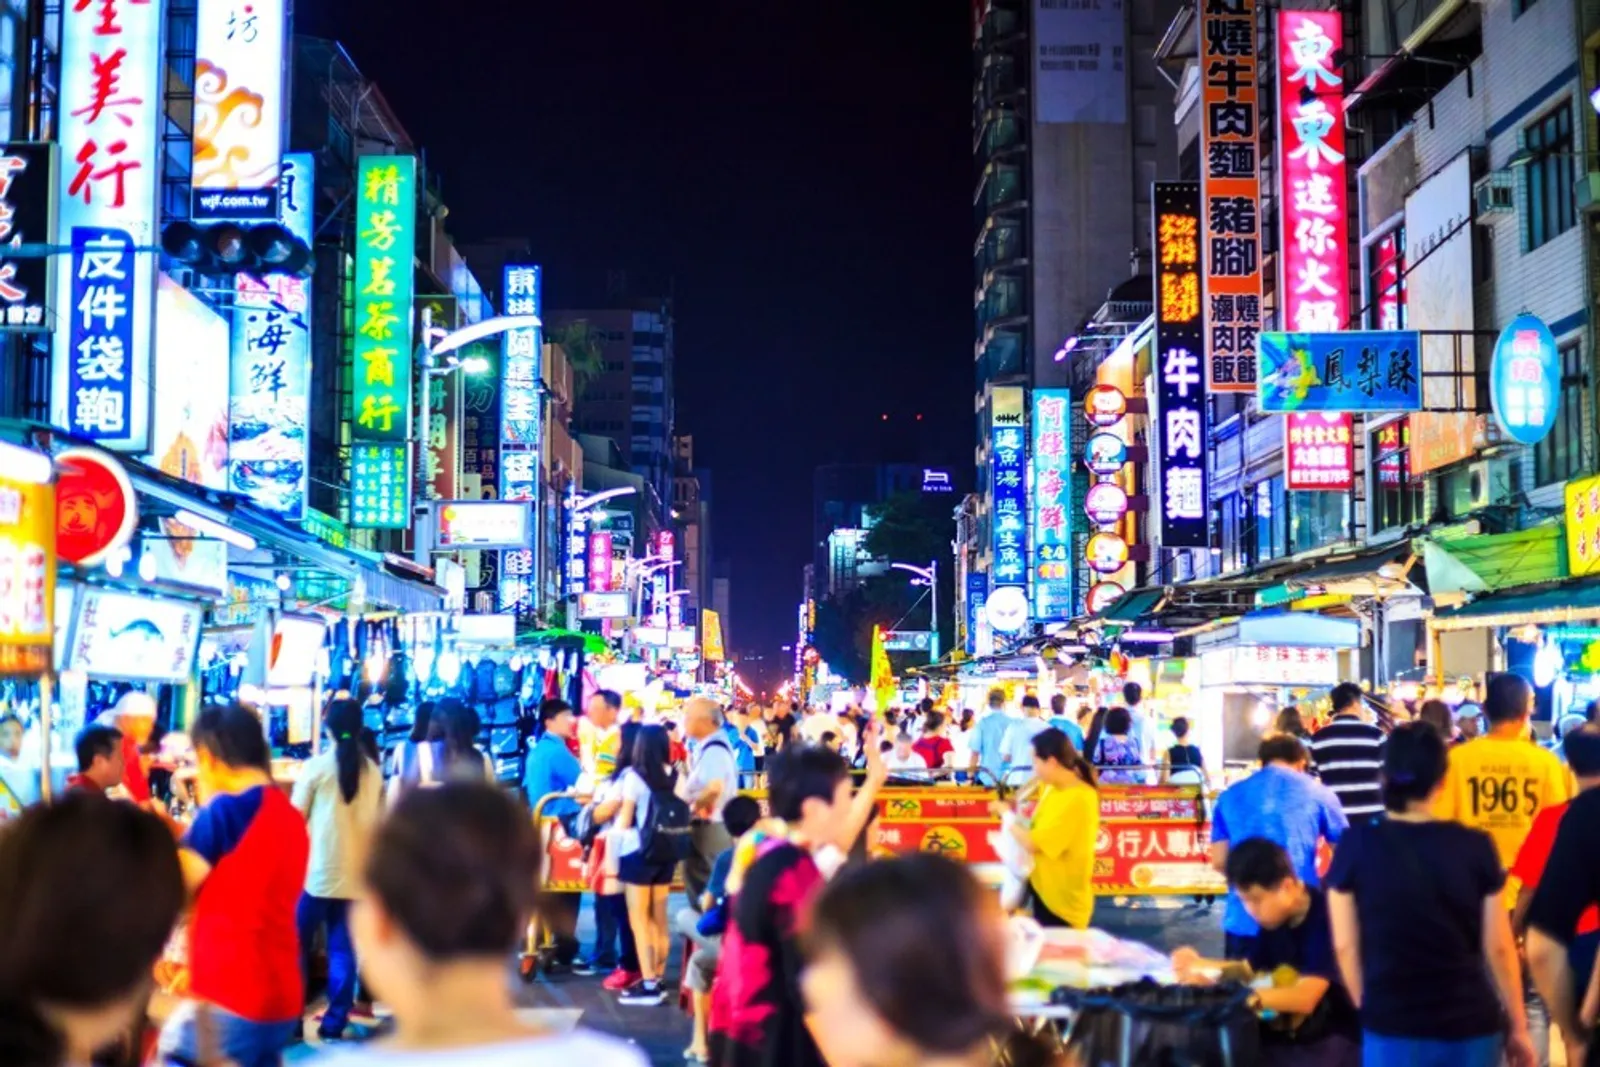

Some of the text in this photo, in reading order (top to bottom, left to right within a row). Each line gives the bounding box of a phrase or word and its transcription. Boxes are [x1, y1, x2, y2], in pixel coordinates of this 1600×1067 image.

[1209, 197, 1258, 276] 豬腳
[247, 311, 292, 402] 海鮮
[1211, 295, 1235, 383] 滷肉飯
[1326, 346, 1417, 396] 鳳梨酥
[1037, 395, 1068, 538] 阿輝海鮮
[1164, 348, 1204, 519] 牛肉麵
[1256, 647, 1329, 663] 珍珠玉米
[1468, 777, 1538, 817] 1965
